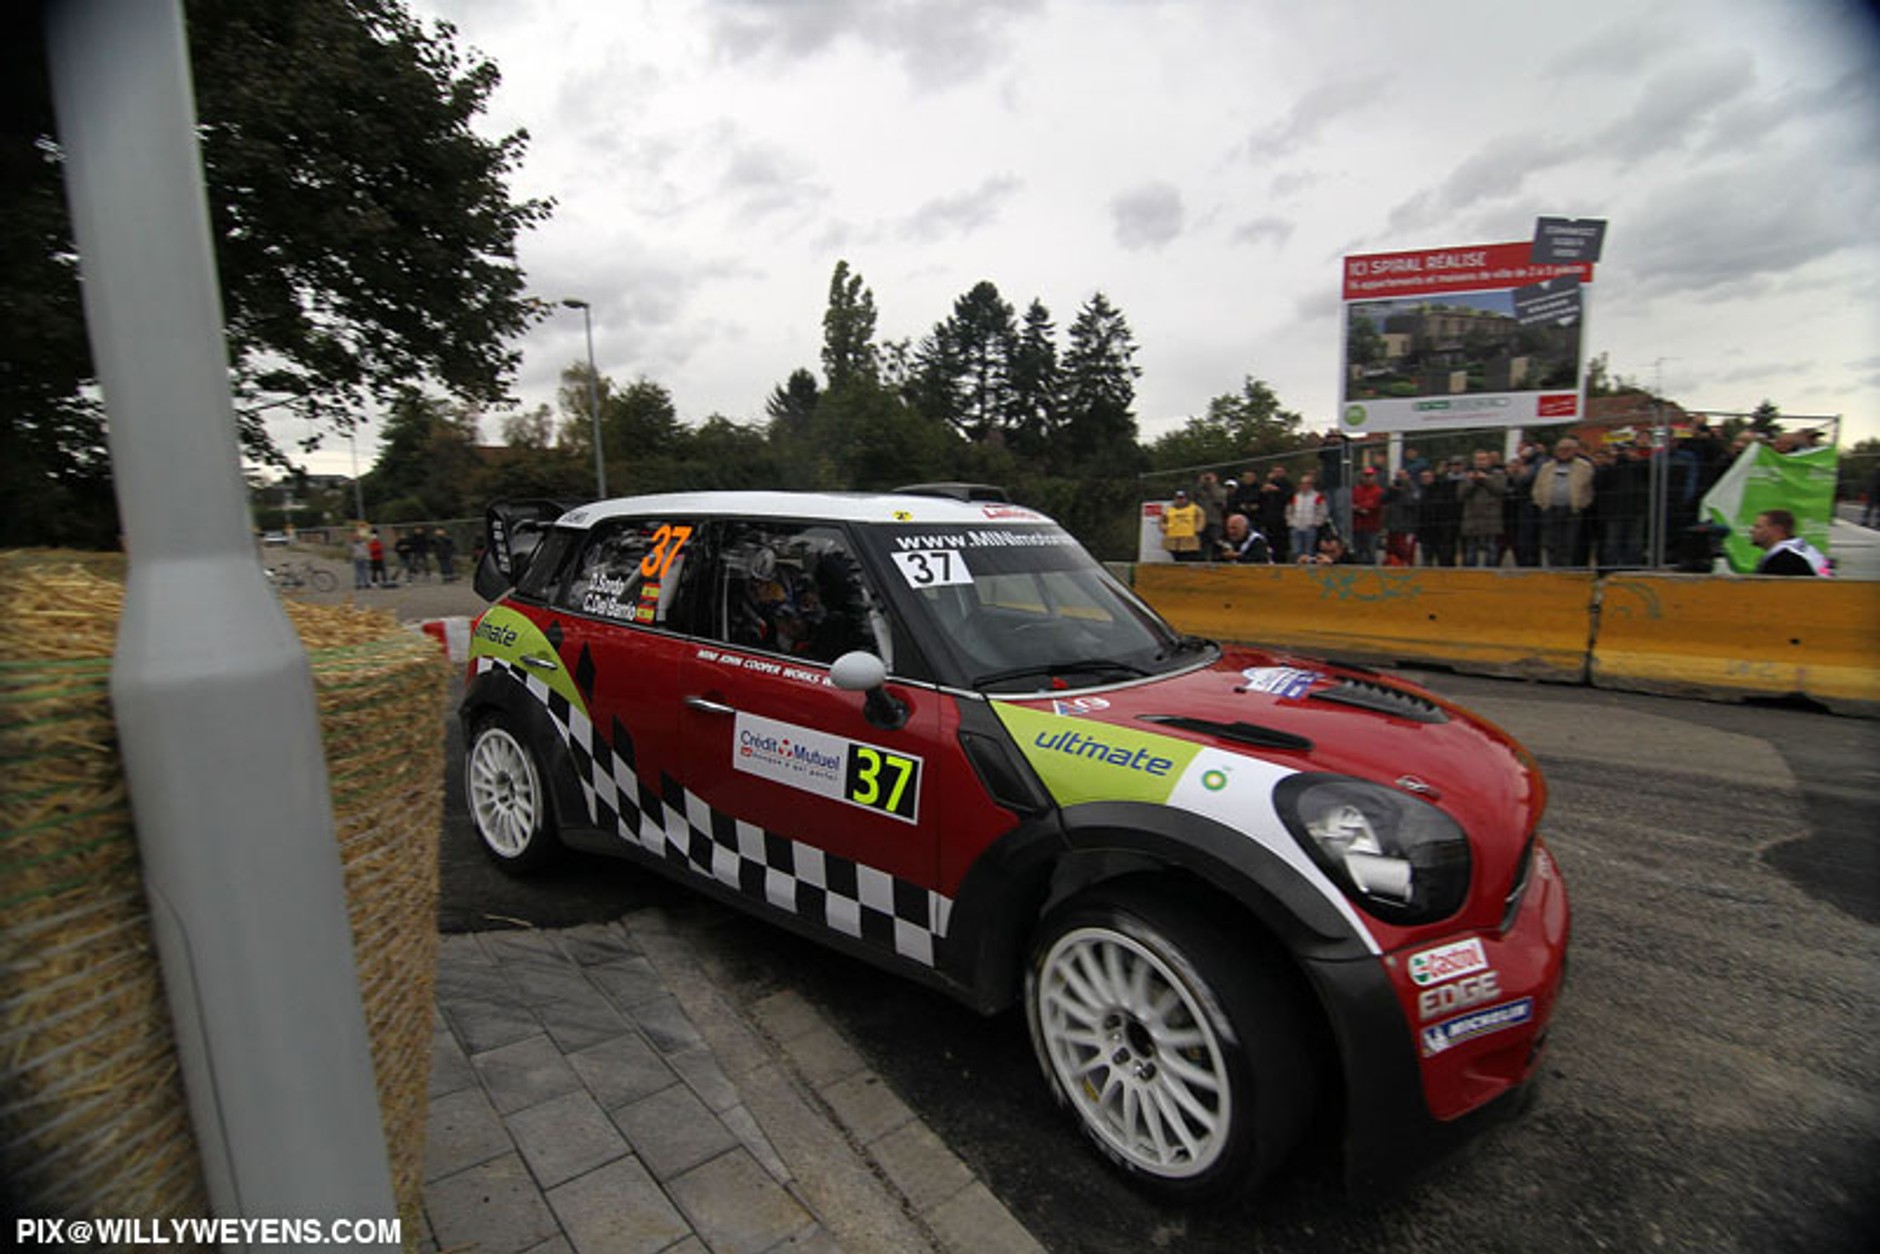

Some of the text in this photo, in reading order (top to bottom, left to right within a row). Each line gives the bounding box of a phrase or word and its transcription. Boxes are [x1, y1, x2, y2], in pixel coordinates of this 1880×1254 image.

[641, 525, 692, 579] 37
[907, 552, 951, 584] 37
[697, 650, 718, 661] MINI
[718, 655, 743, 666] JOHN
[743, 660, 781, 675] COOPER
[782, 667, 821, 684] WORKS
[740, 729, 777, 753] Crédit
[794, 744, 840, 771] Mutuel
[1034, 730, 1173, 777] ultimate
[853, 747, 913, 813] 37
[1418, 970, 1502, 1021] EDGE
